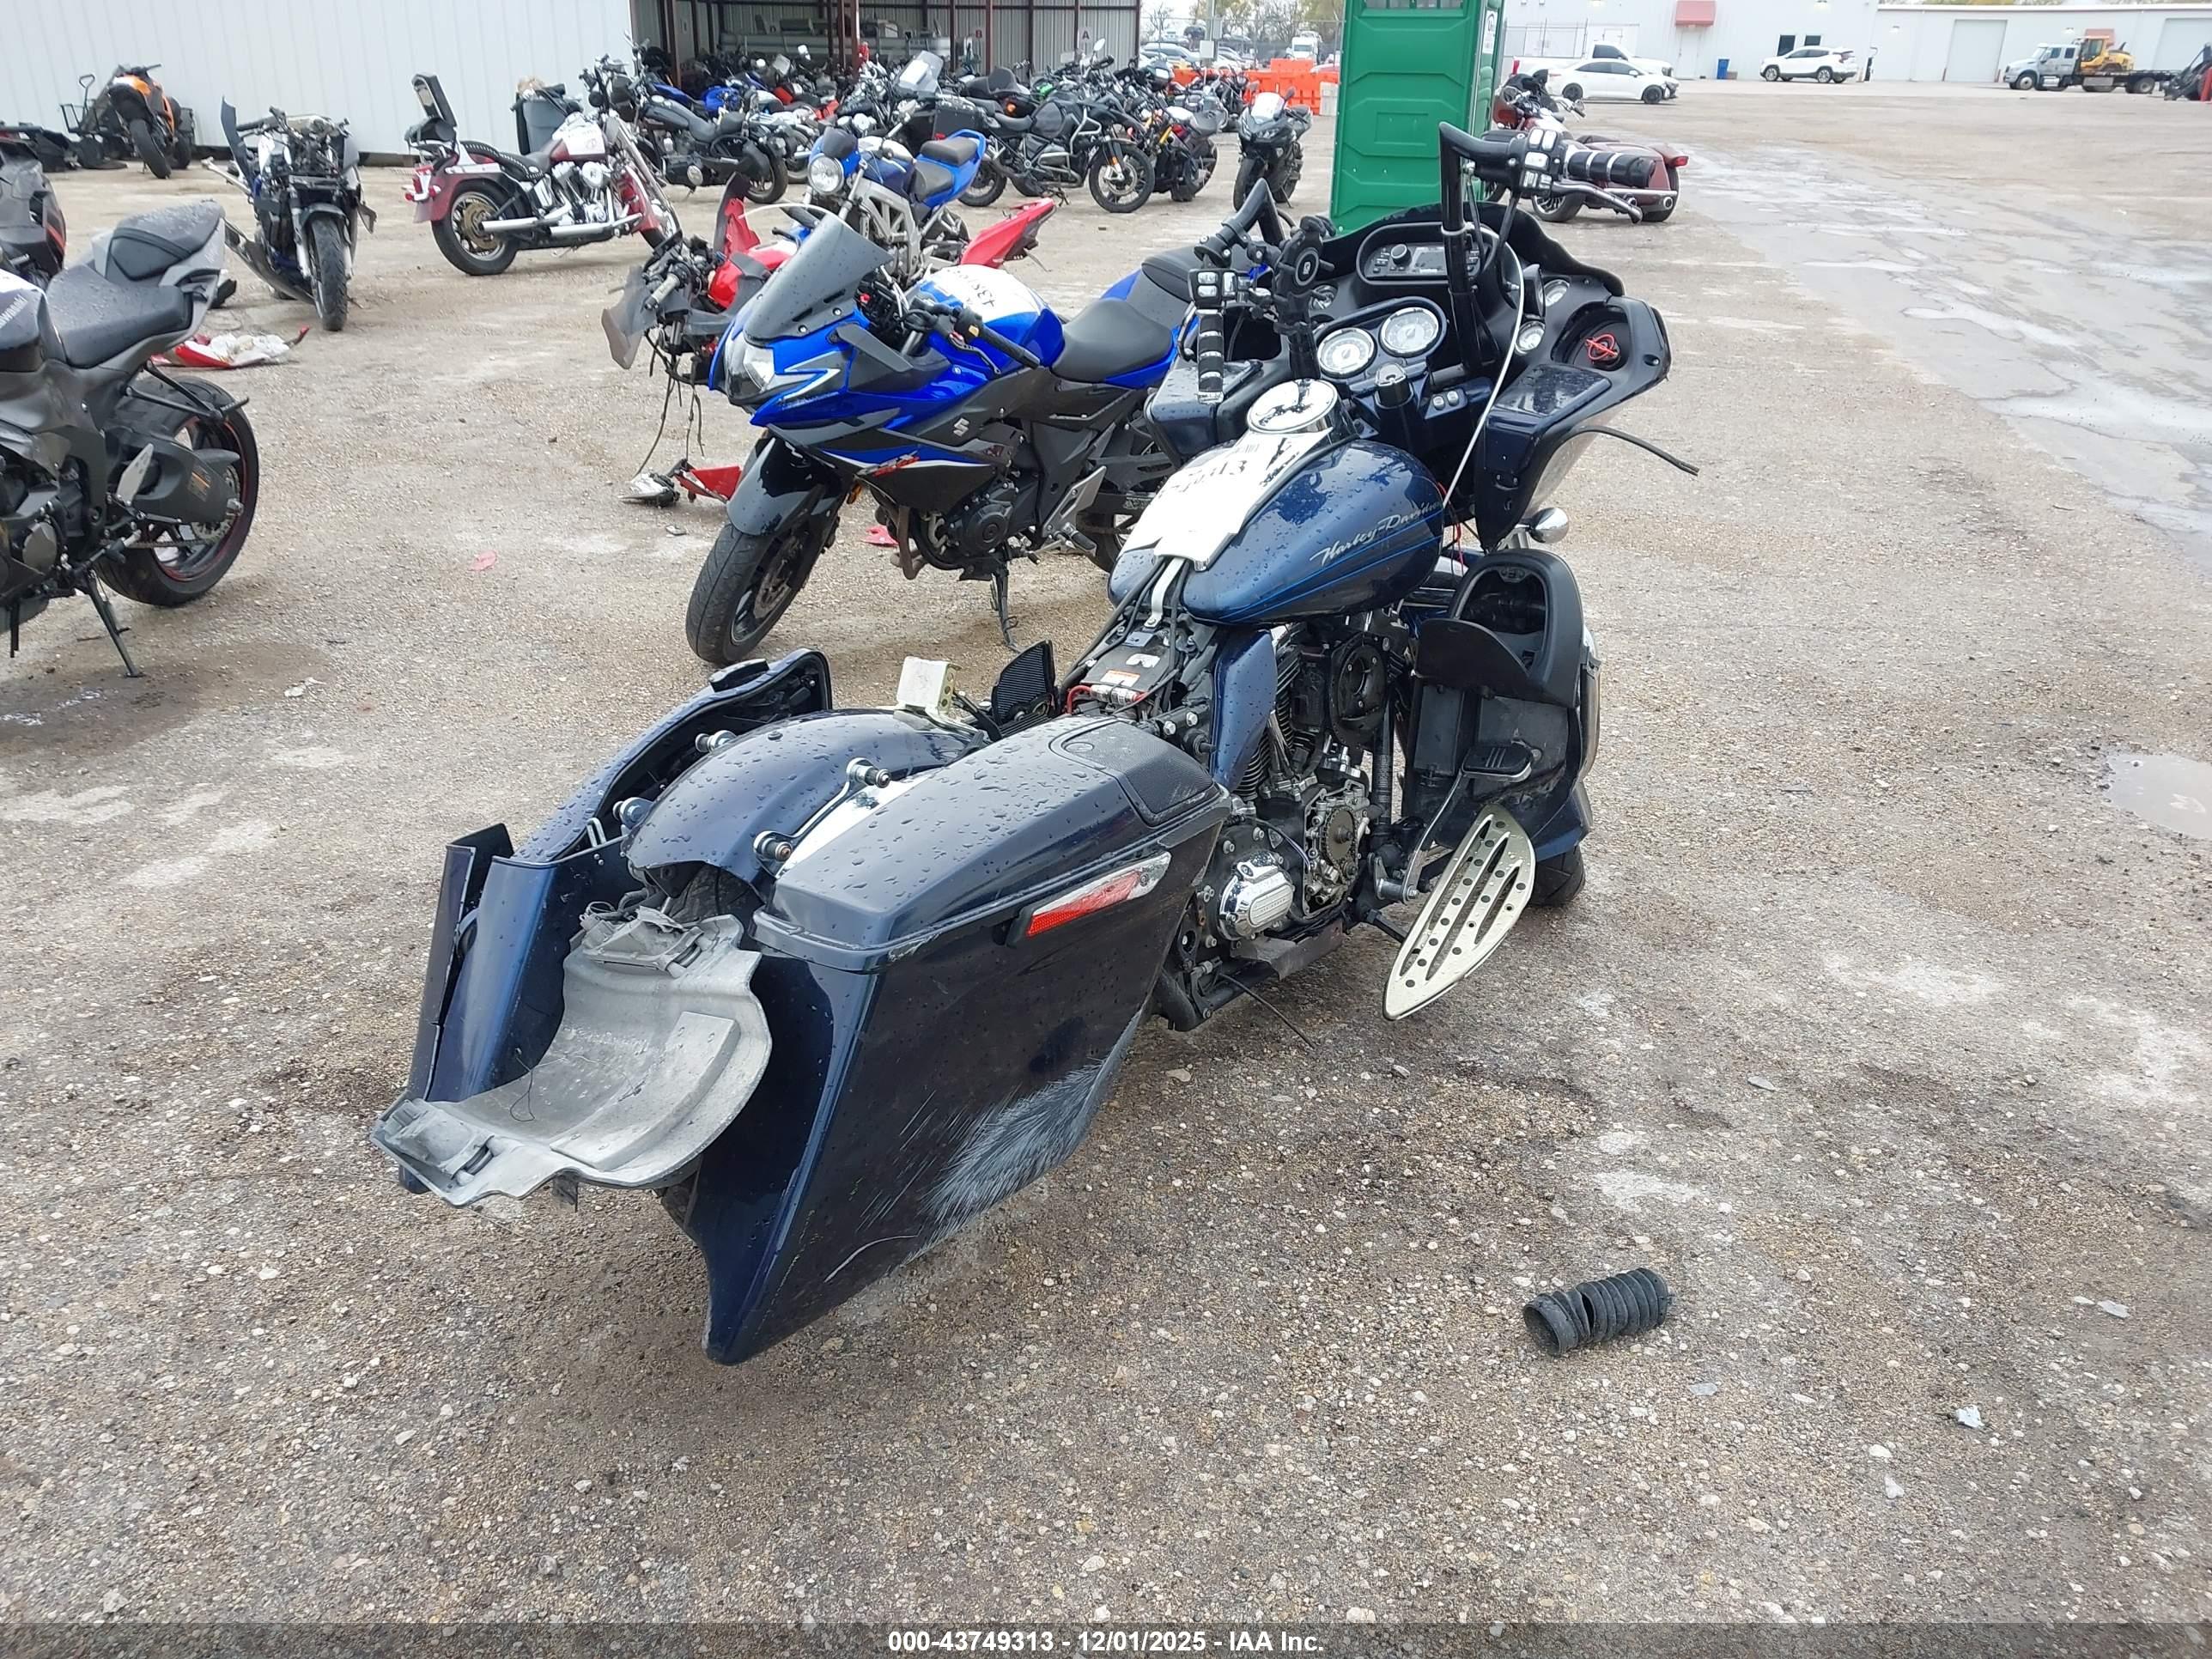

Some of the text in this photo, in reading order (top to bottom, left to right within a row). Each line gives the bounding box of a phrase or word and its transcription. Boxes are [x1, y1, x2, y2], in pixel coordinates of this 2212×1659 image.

[975, 29, 983, 39] B
[1082, 30, 1090, 40] A
[1309, 501, 1443, 567] Harley-Davidson
